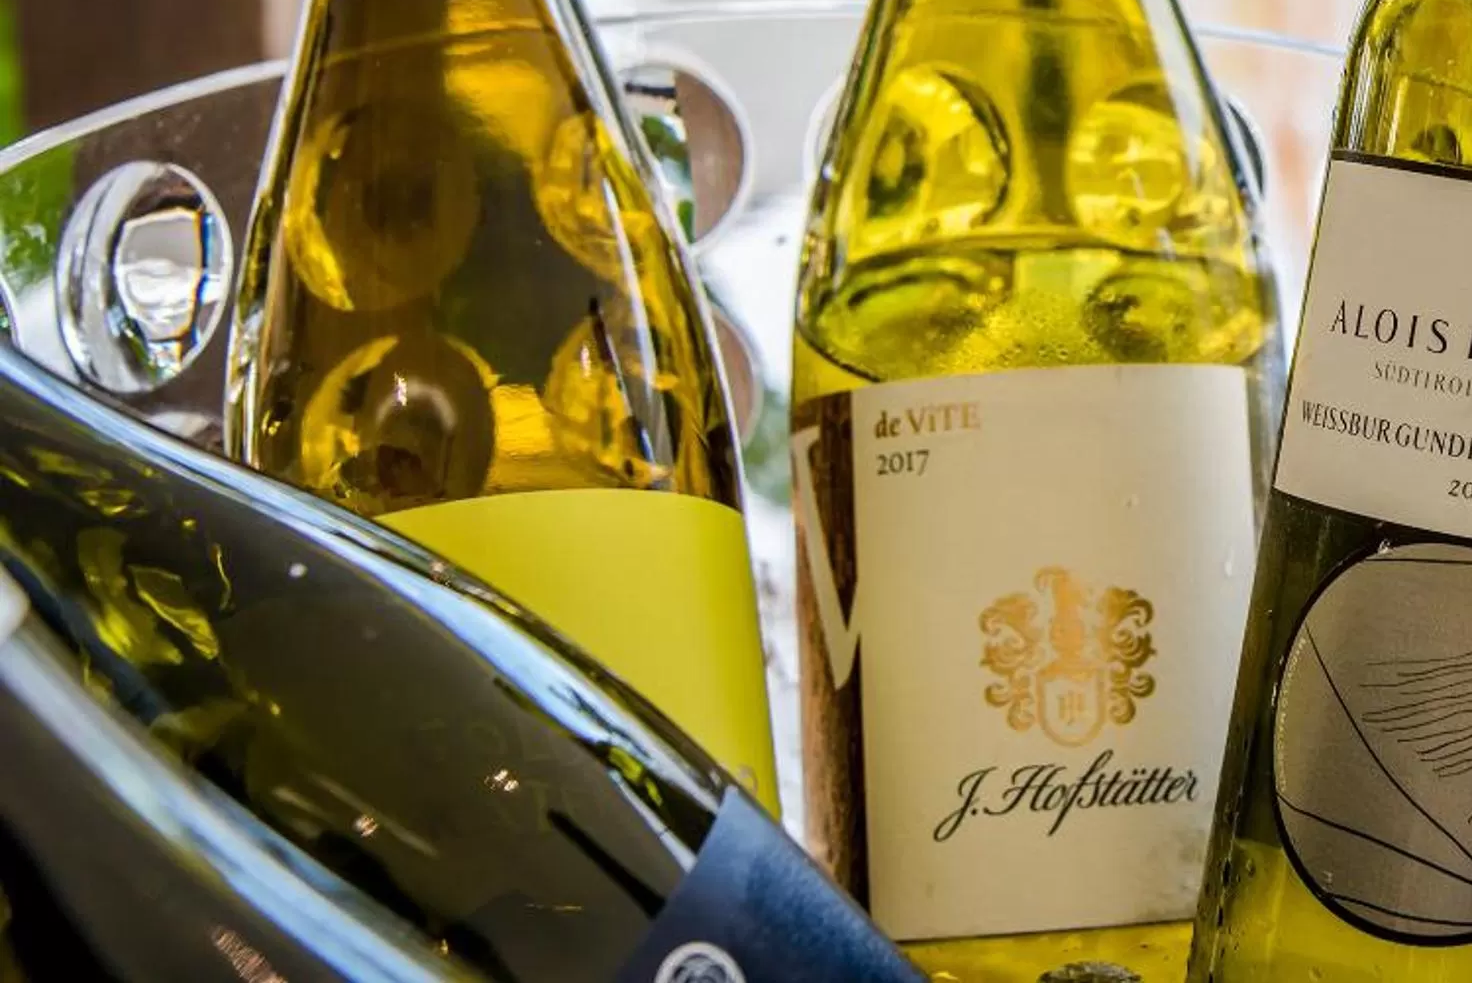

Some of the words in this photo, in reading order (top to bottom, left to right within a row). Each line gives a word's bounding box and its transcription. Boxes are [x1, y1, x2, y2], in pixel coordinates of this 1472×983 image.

[1329, 299, 1450, 355] ALOIS
[874, 409, 902, 439] de
[876, 448, 930, 477] 2017
[932, 765, 998, 842] J.
[983, 748, 1199, 837] Hofstätter
